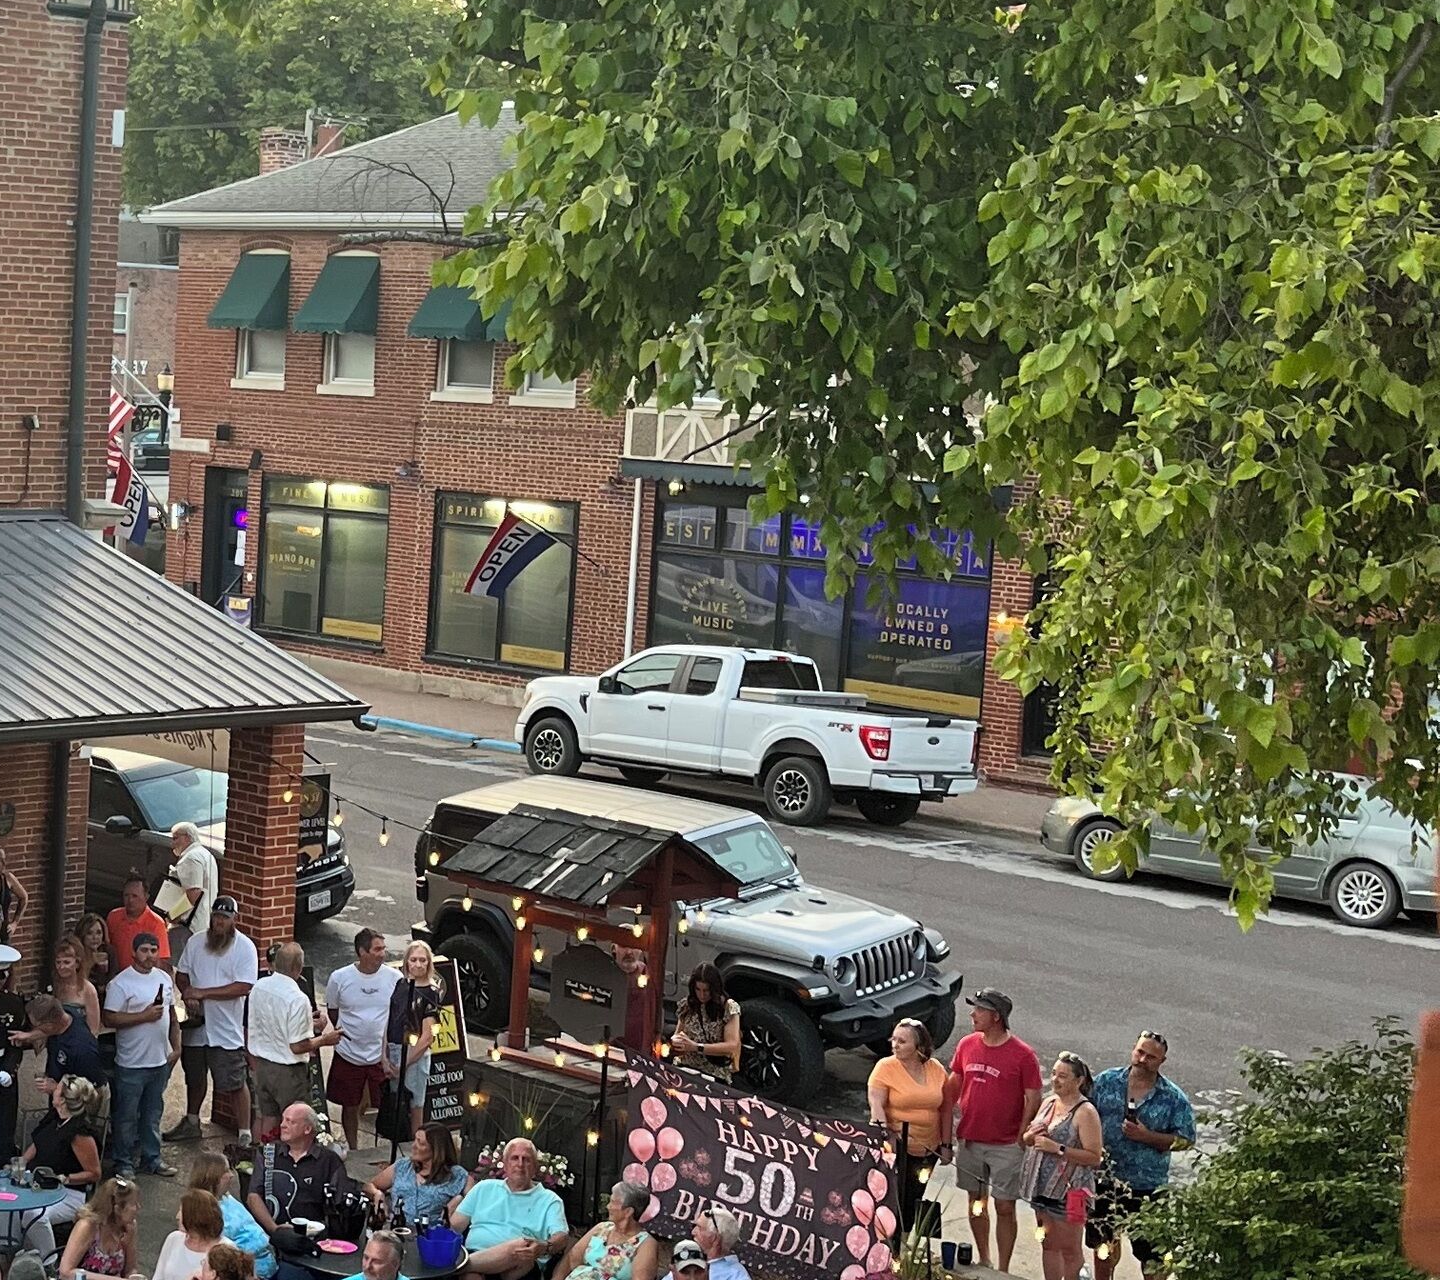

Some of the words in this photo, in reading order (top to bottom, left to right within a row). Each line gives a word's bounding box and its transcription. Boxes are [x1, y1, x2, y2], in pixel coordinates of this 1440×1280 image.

[666, 521, 711, 541] EST
[478, 526, 532, 582] OPEN
[298, 556, 316, 569] BAR
[699, 601, 729, 614] LIVE
[896, 603, 949, 619] OCALLY
[692, 615, 734, 630] MUSIC
[880, 631, 952, 650] OPERATED
[434, 1061, 446, 1072] NO
[431, 1095, 458, 1108] DRINKS
[430, 1106, 464, 1120] ALLOWED
[714, 1118, 820, 1172] HAPPY
[715, 1146, 796, 1218] 50
